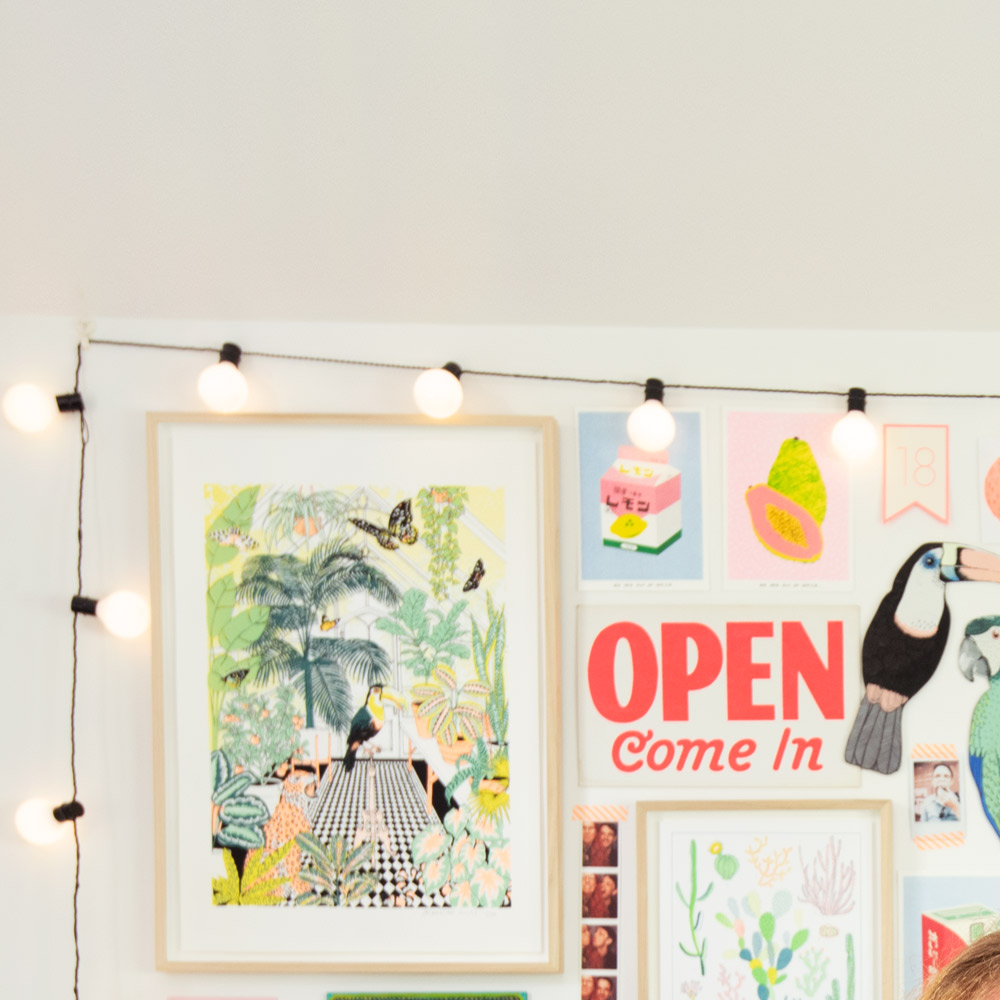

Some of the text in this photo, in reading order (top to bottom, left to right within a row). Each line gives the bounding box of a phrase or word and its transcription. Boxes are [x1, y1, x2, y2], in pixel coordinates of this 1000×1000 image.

[896, 446, 937, 488] 18
[605, 494, 651, 513] レモン
[587, 620, 845, 724] OPEN
[611, 727, 824, 773] Come In
